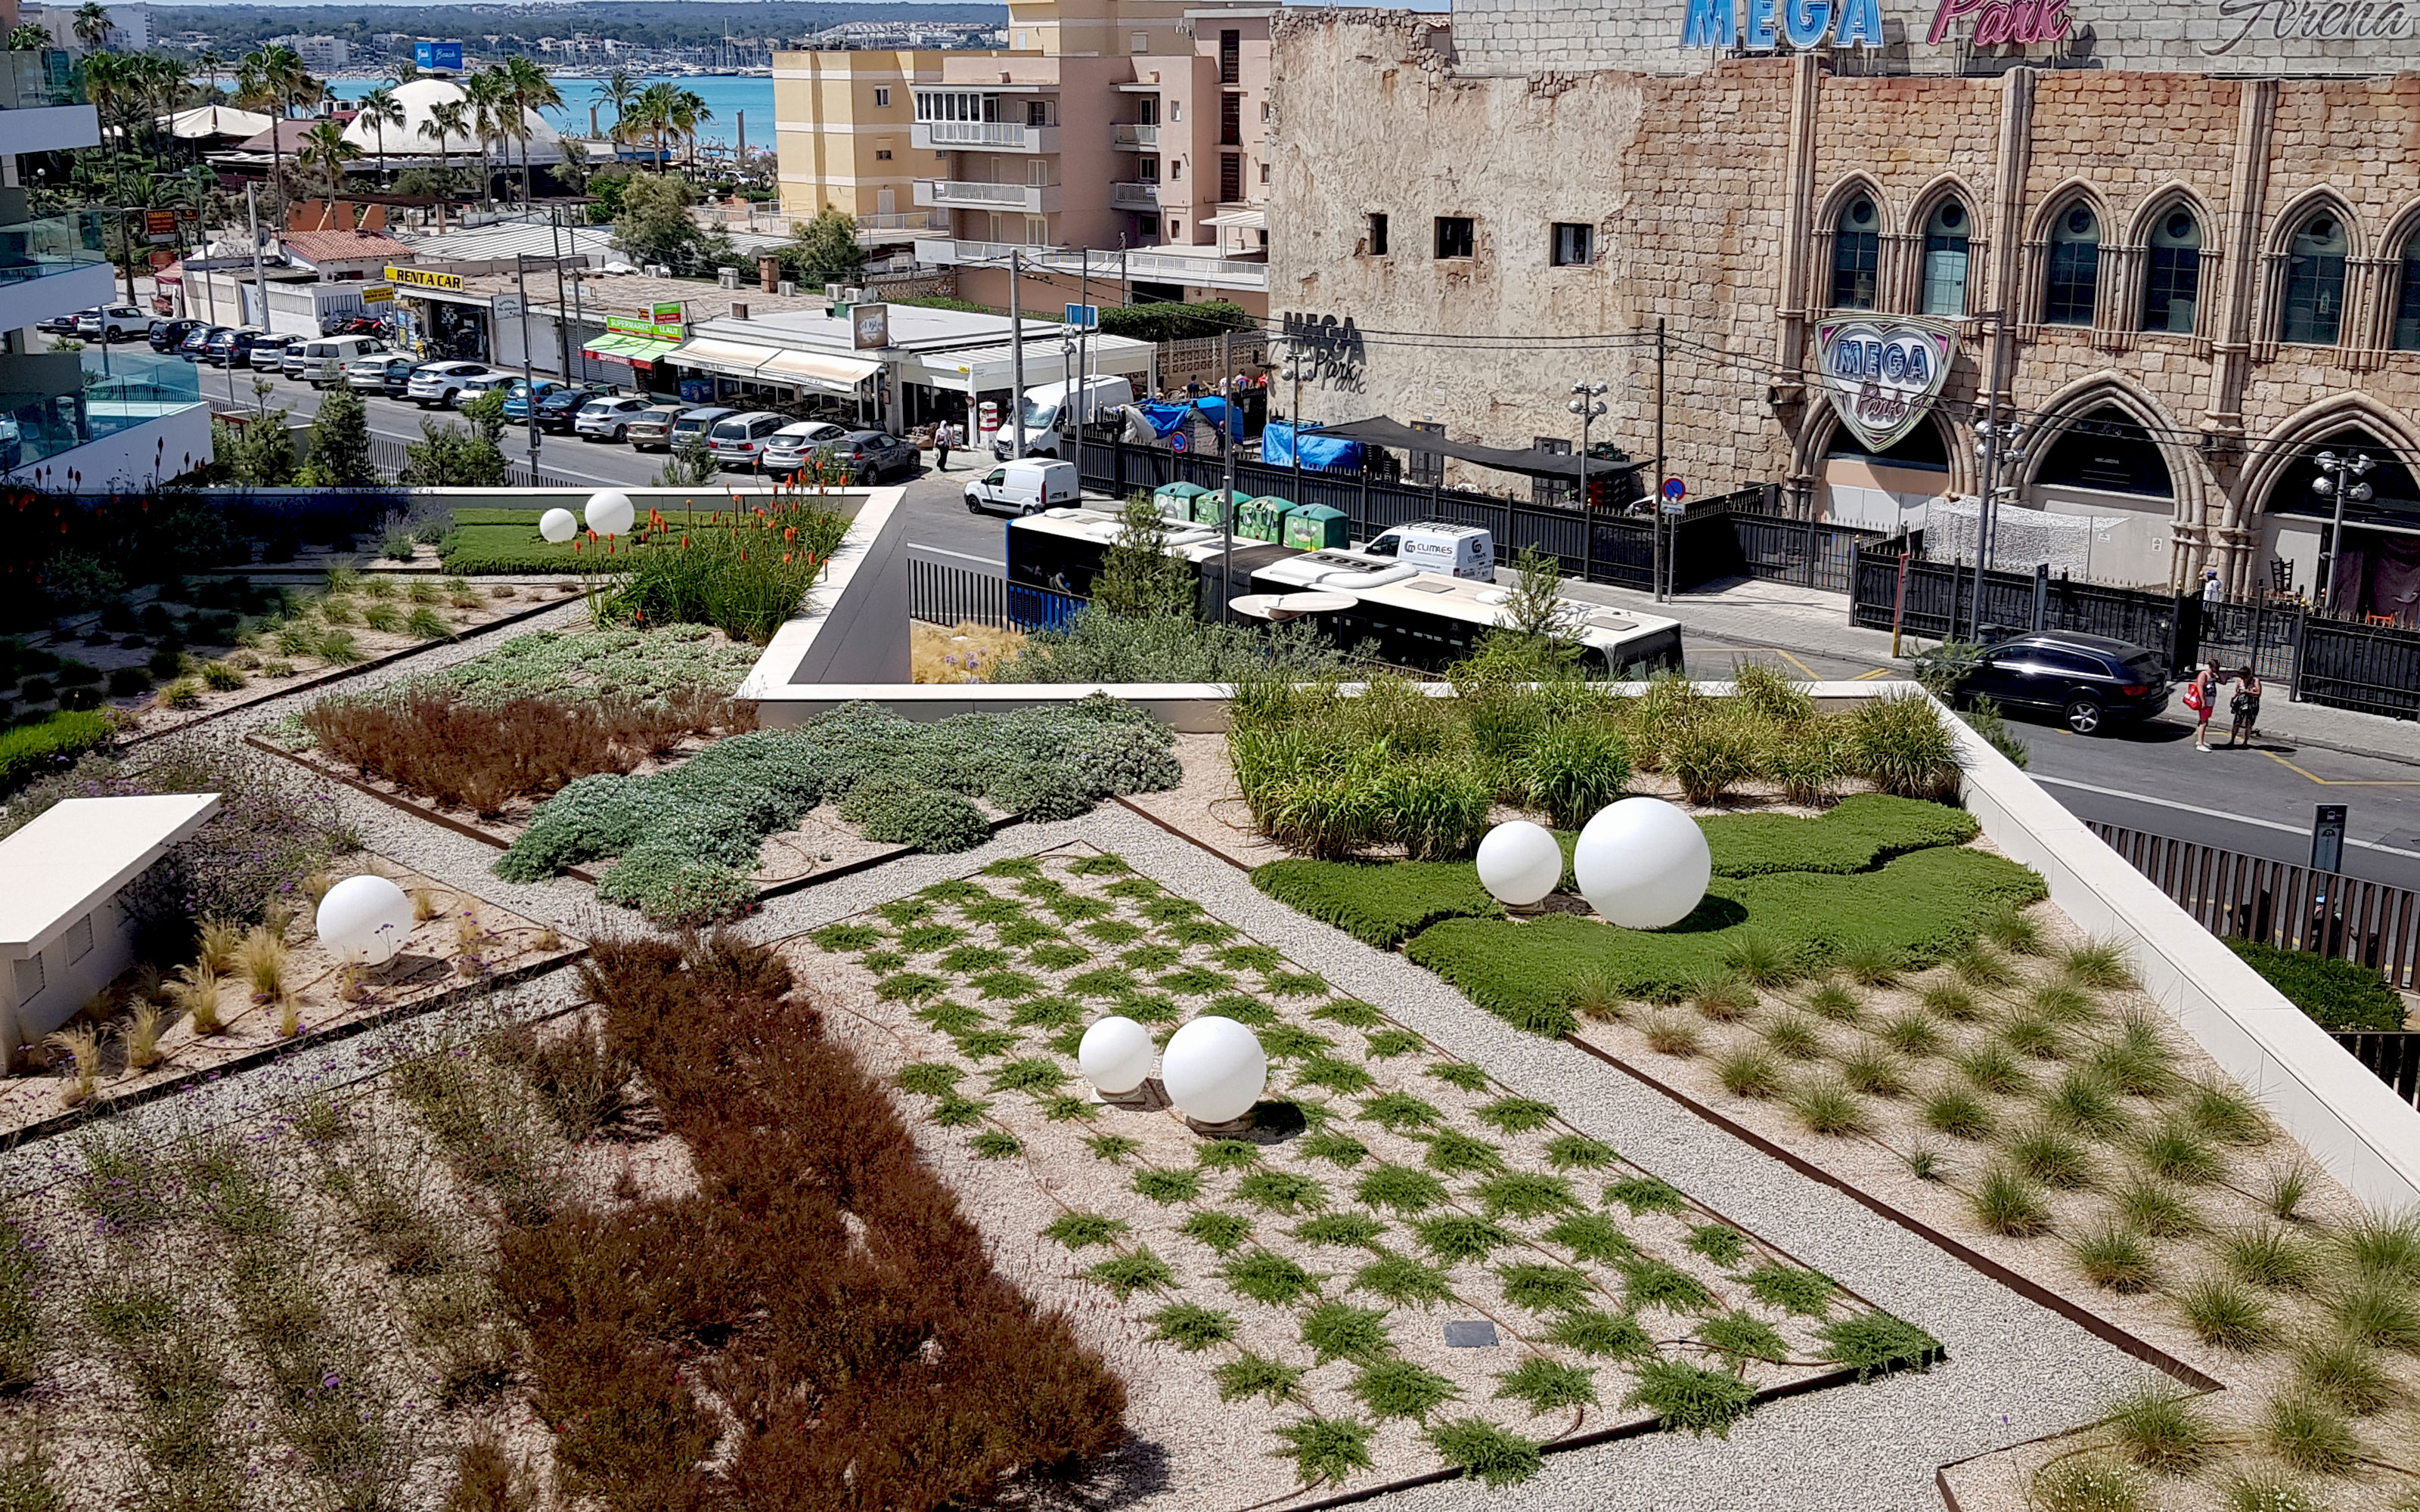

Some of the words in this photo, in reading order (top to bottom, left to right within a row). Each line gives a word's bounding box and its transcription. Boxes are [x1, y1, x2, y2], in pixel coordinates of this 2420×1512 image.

[1678, 0, 1885, 51] MEGA
[396, 269, 425, 285] RENT
[426, 273, 435, 286] A
[436, 275, 461, 290] CAR
[1834, 339, 1929, 380] MEGA
[1855, 380, 1906, 418] Park
[1416, 543, 1453, 555] CLIMAES
